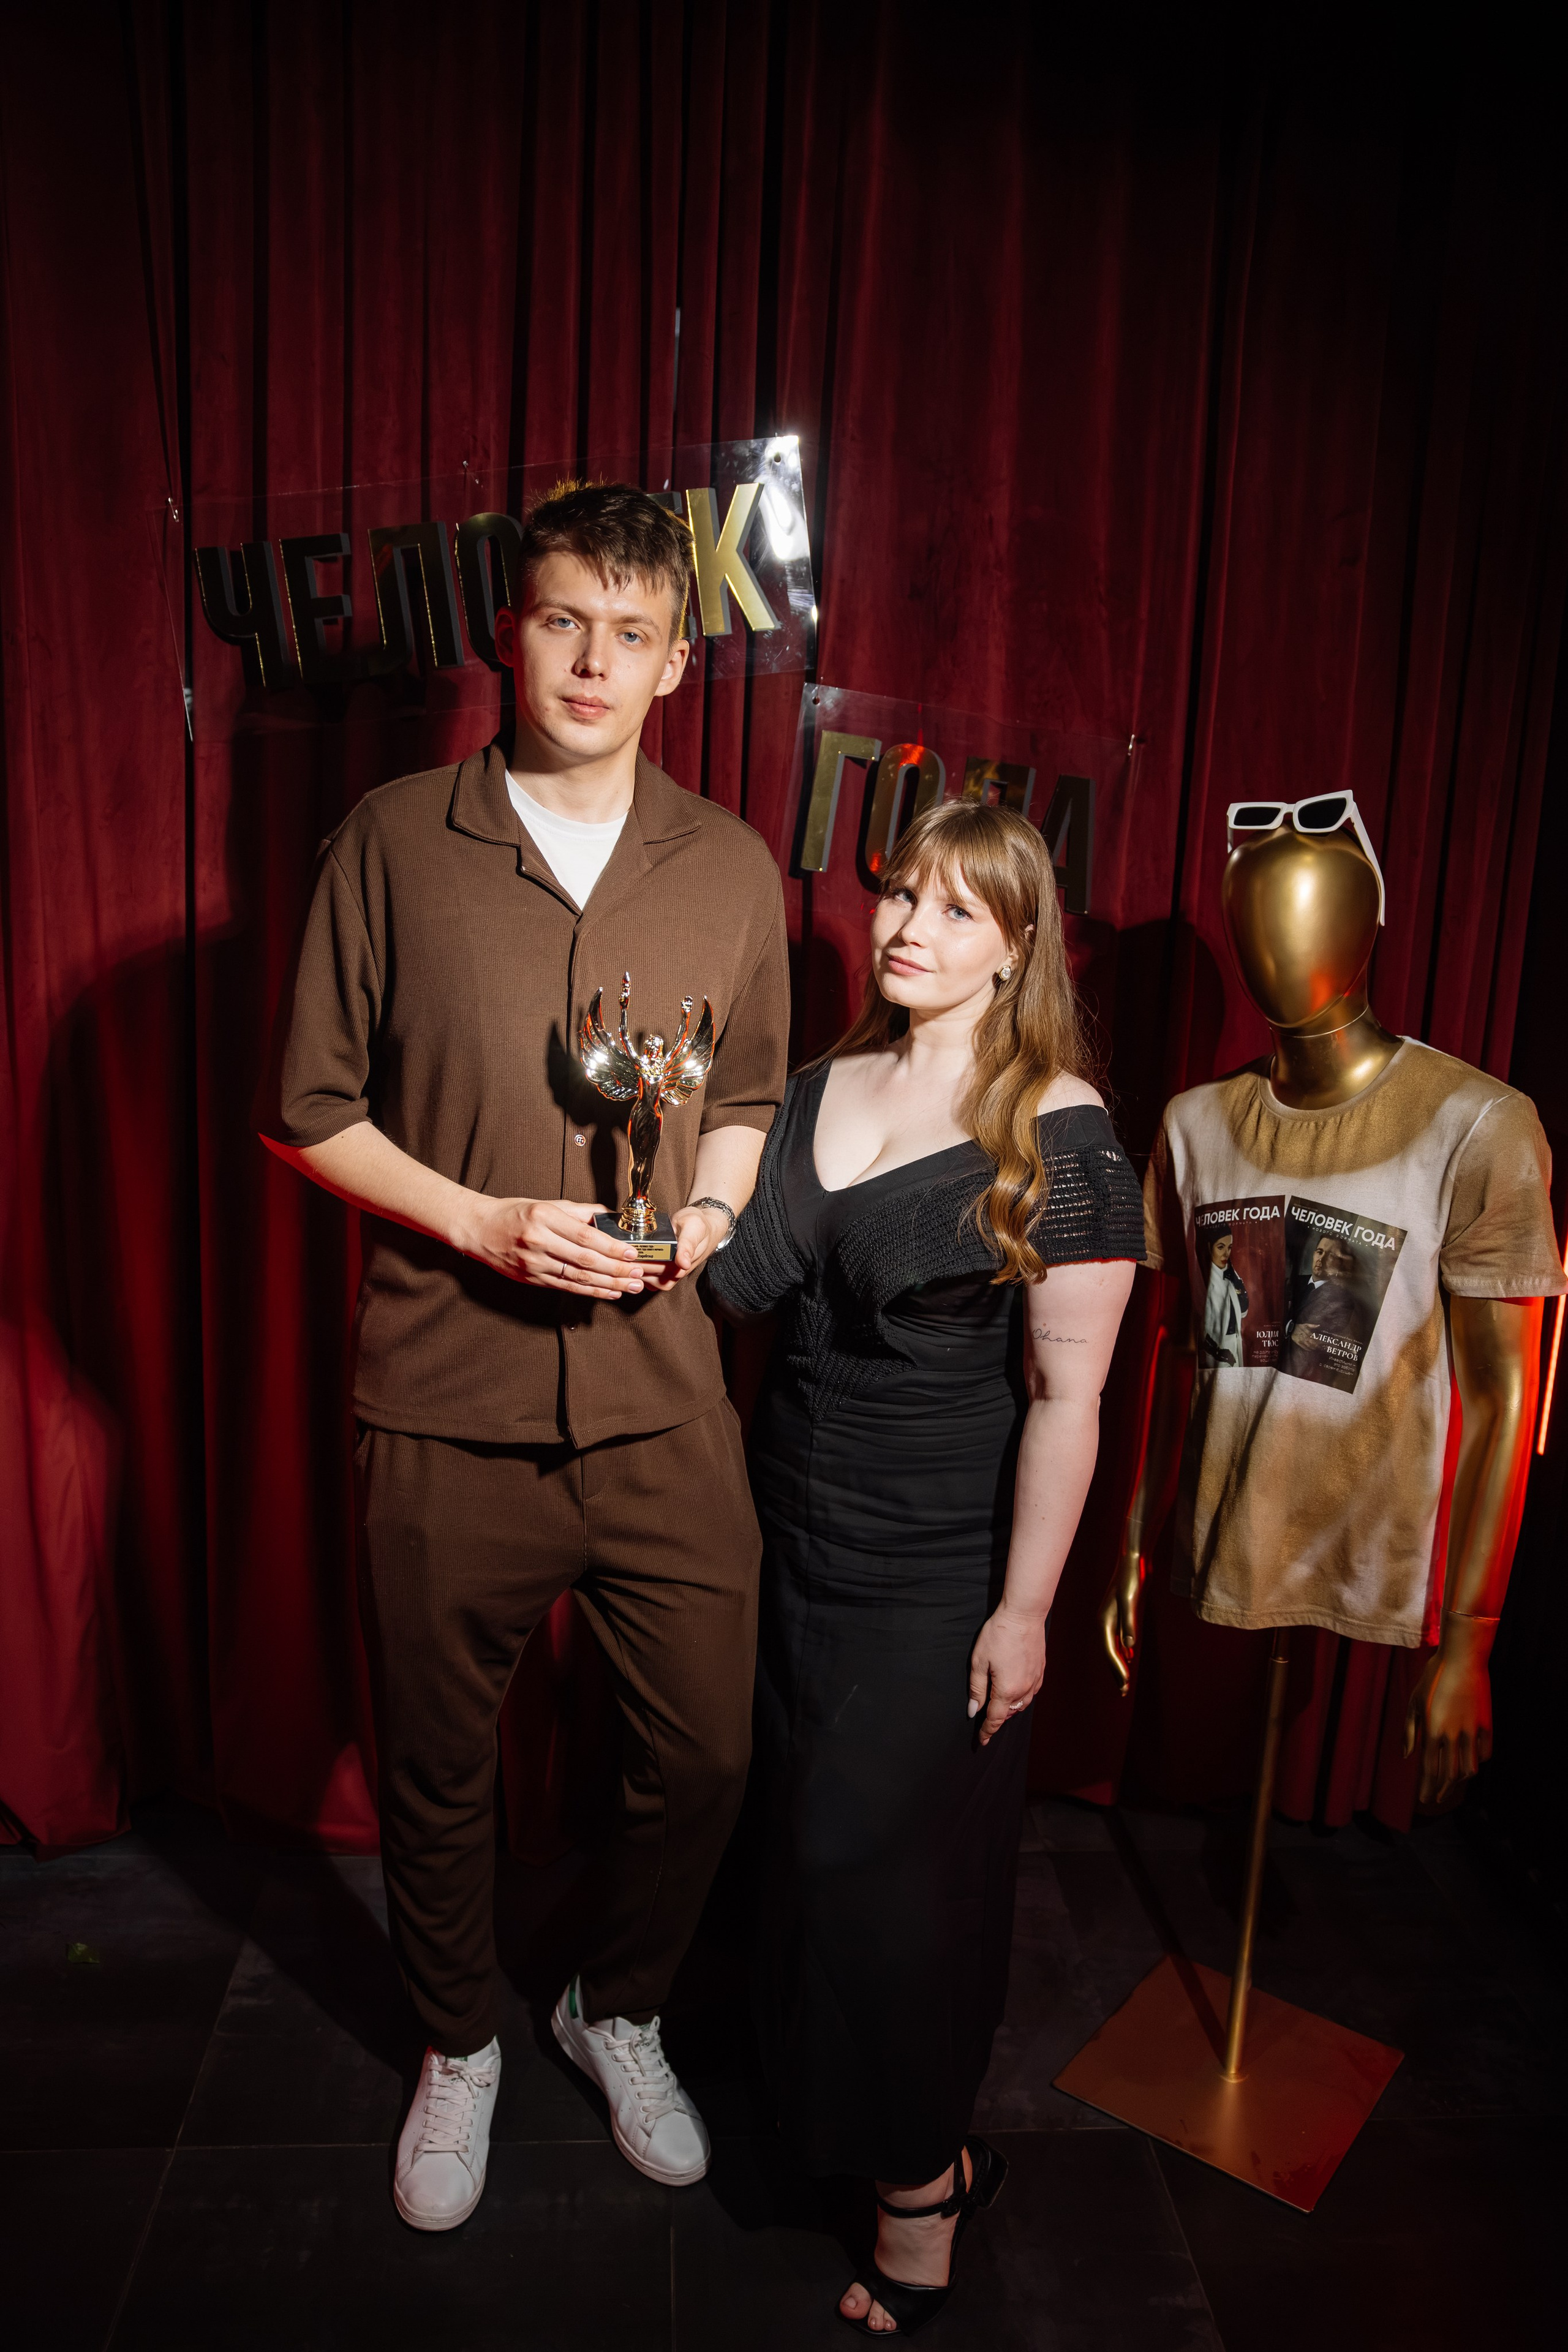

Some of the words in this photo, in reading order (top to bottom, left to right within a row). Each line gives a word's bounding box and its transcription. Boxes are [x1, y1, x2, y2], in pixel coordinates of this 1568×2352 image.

[195, 482, 782, 688] ЧЕЛОК
[1243, 1205, 1280, 1221] ГОДА
[1291, 1207, 1353, 1235] ЧЕЛОВЕК
[1354, 1226, 1395, 1251] ГОДА
[1032, 1328, 1088, 1343] Ohana
[1310, 1332, 1362, 1352] АЛЕКСАНДР
[1327, 1346, 1358, 1362] ВЕТРОВ
